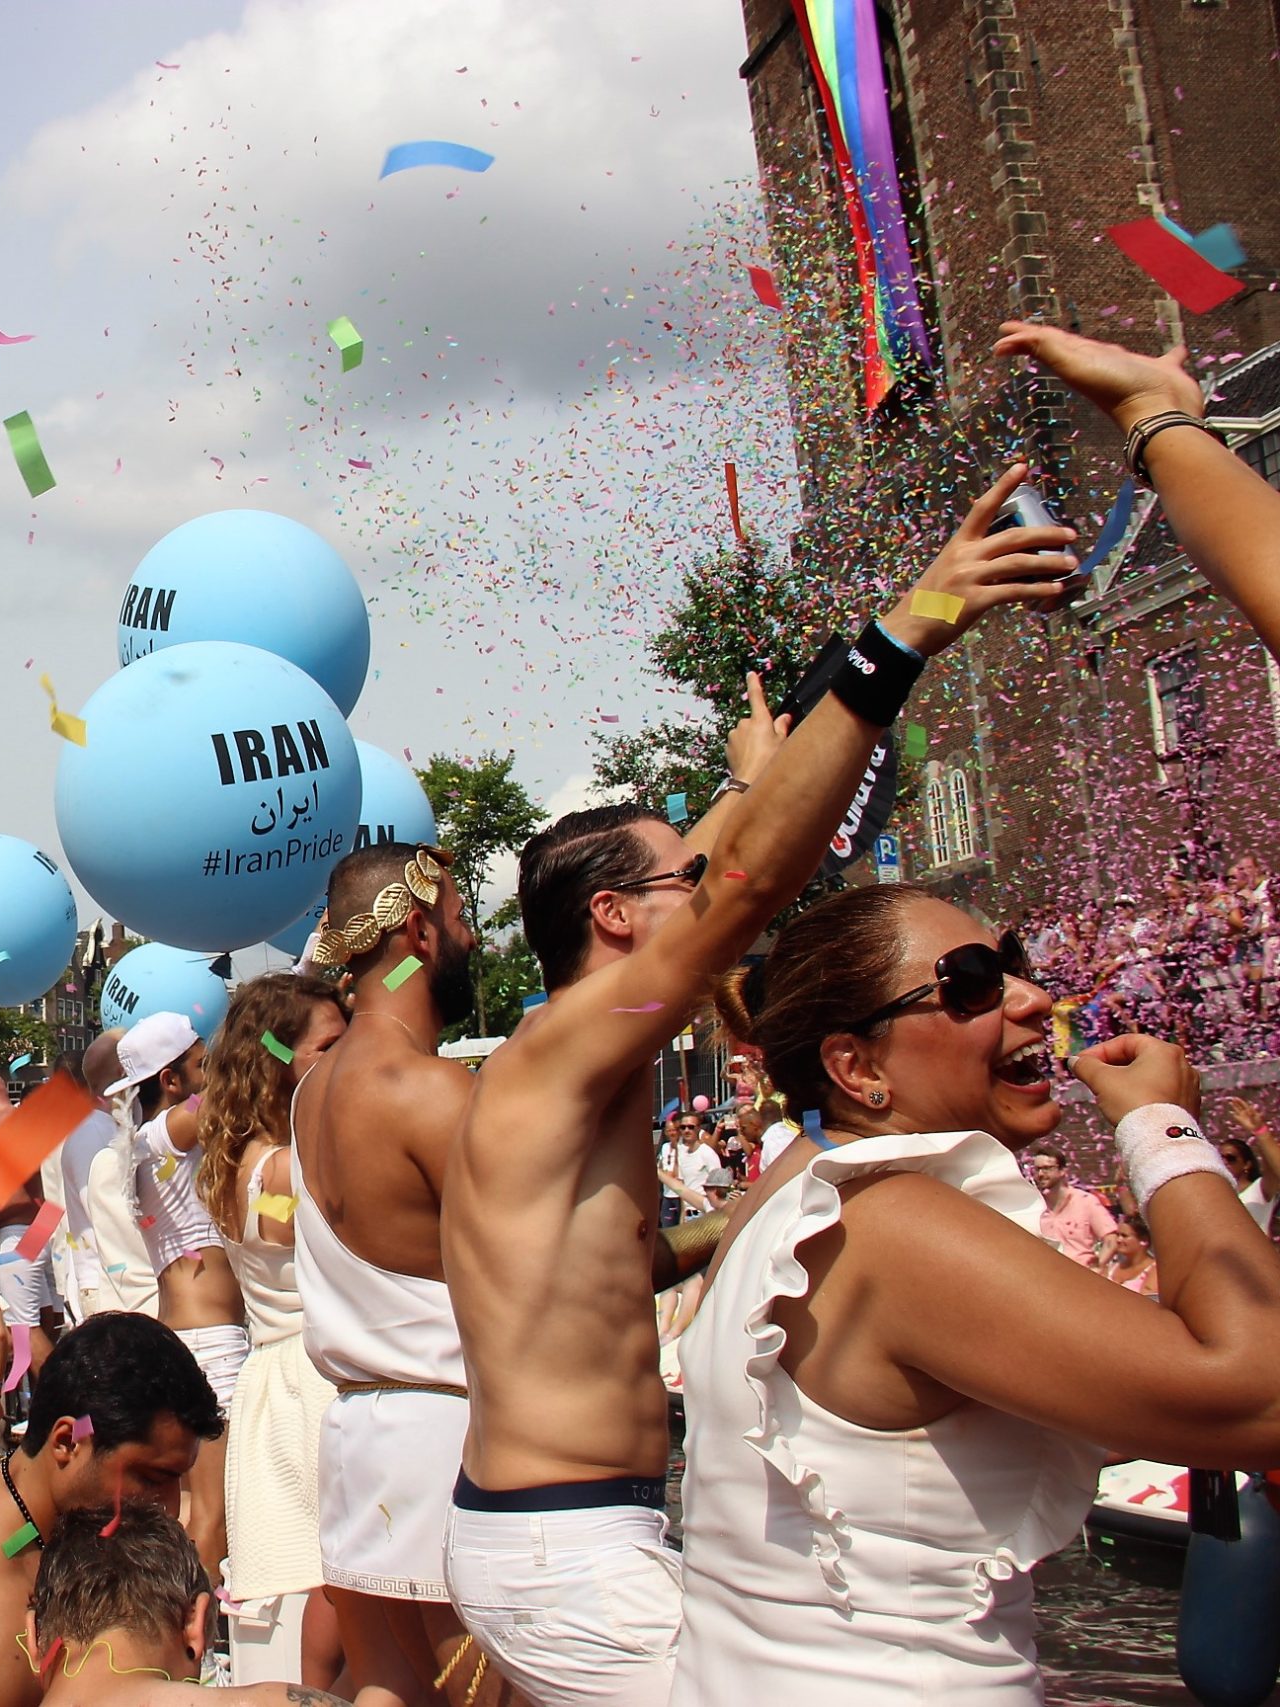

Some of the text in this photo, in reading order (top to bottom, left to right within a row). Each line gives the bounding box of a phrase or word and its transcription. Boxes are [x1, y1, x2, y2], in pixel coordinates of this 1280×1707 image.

[119, 583, 177, 632] IRAN
[211, 719, 330, 786] IRAN
[251, 780, 319, 836] ایران
[202, 829, 343, 876] #IranPride
[880, 838, 892, 862] P
[106, 974, 140, 1015] IRAN
[632, 1485, 665, 1500] TOM
